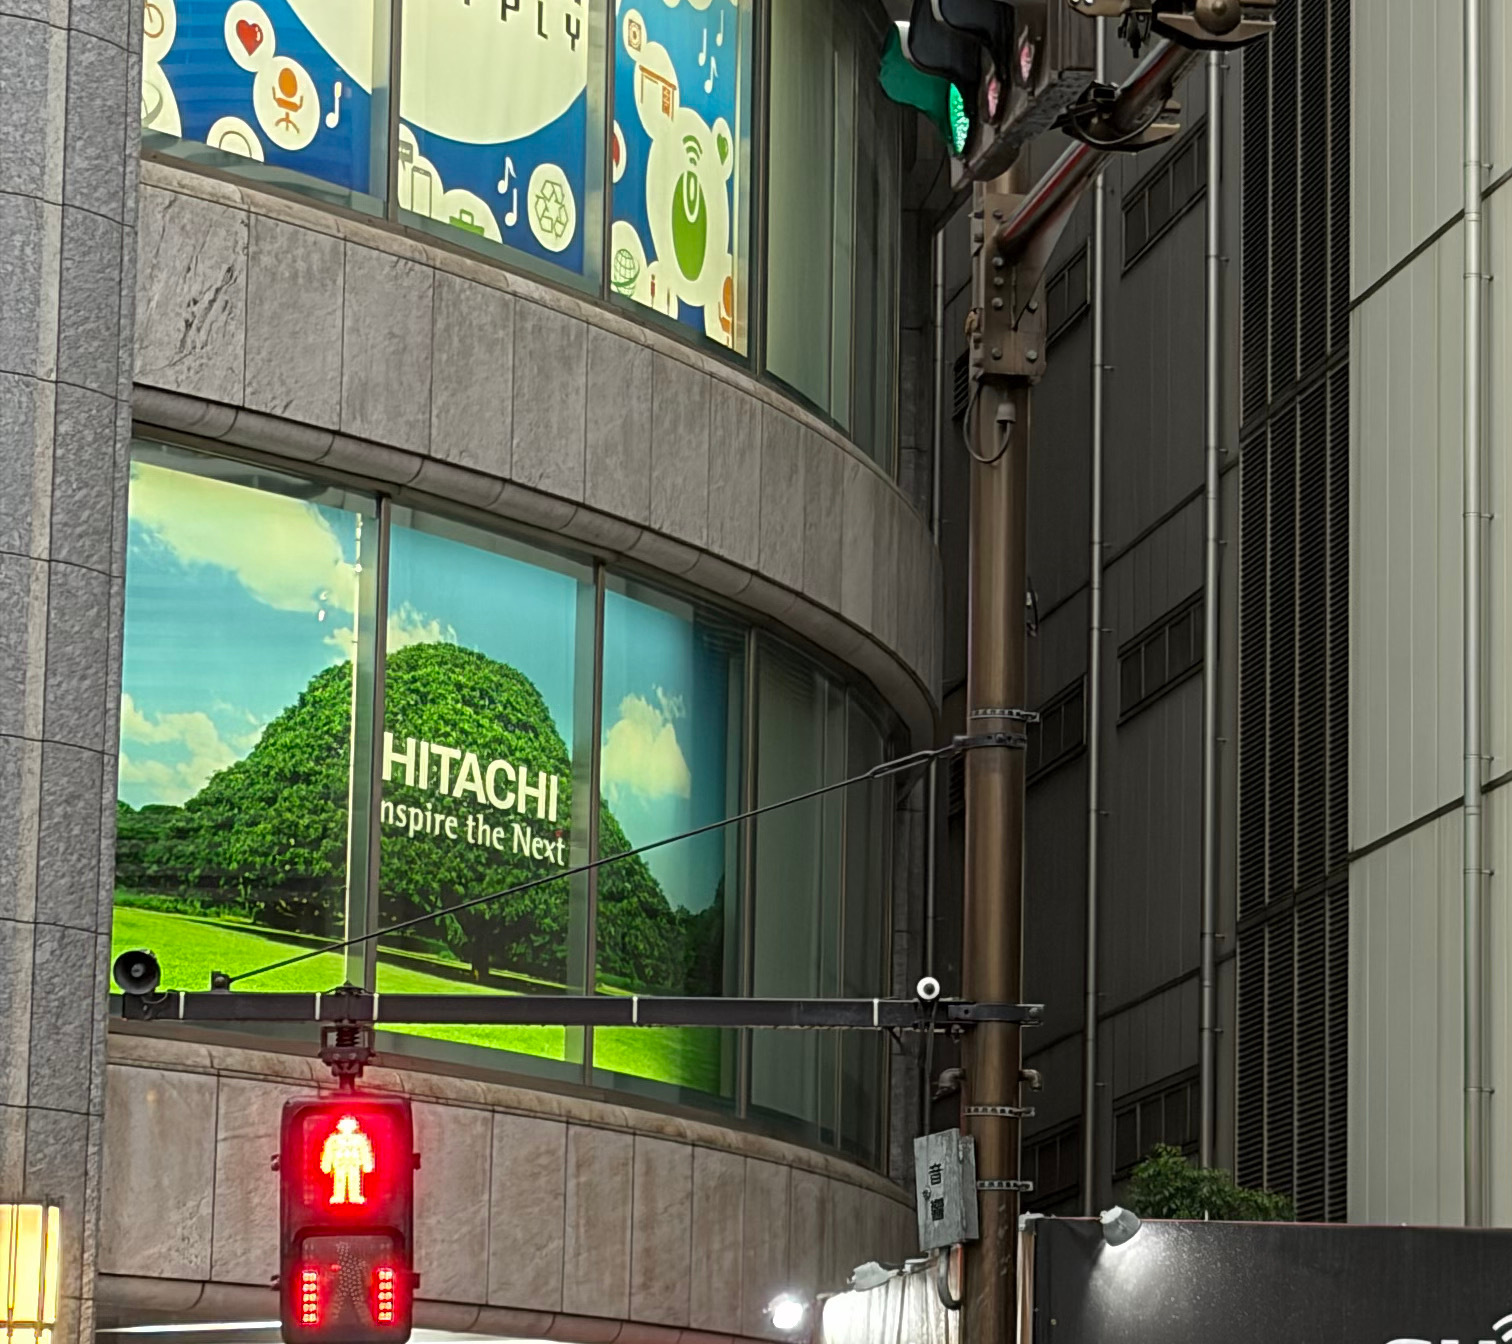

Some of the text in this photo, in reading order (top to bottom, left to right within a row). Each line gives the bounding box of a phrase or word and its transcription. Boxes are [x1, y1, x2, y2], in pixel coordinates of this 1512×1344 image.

[382, 730, 558, 823] HITACHI
[380, 799, 566, 867] nspire the Next
